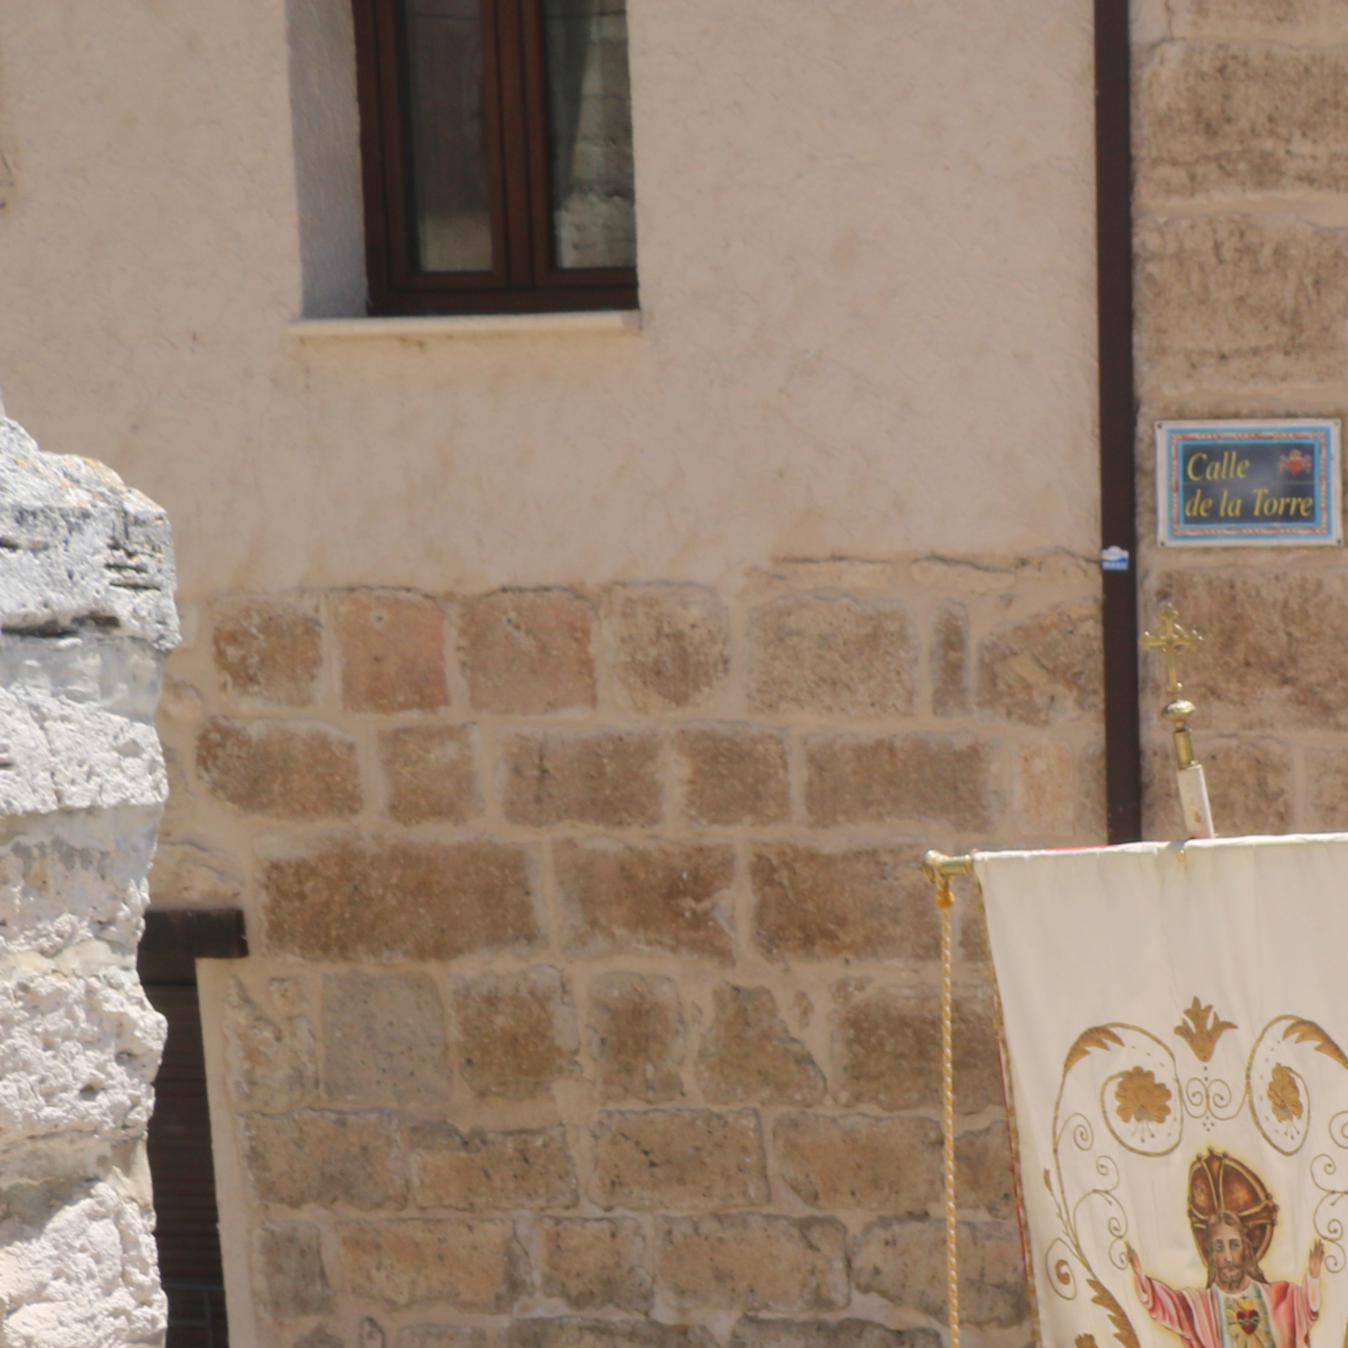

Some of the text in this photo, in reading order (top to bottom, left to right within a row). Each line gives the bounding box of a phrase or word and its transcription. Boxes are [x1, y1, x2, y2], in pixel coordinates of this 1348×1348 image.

[1187, 451, 1250, 481] Calle
[1185, 488, 1314, 517] de la Torre
